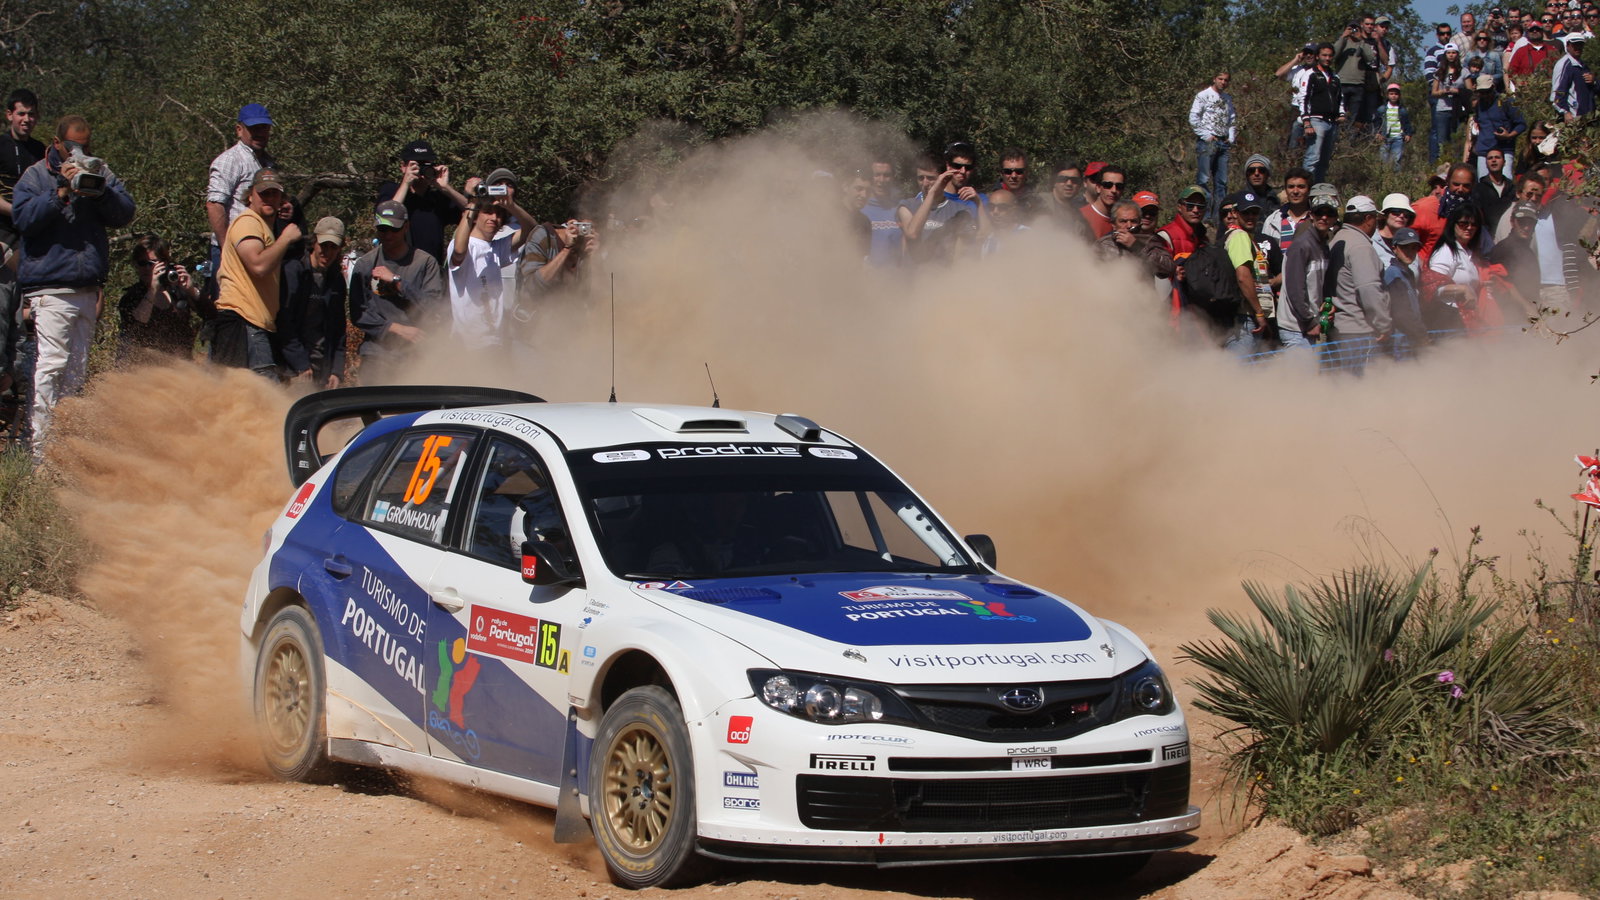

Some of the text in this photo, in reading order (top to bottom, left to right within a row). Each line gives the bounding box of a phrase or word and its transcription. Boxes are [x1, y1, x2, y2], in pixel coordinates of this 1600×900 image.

[440, 411, 541, 440] visitportugal.com
[656, 443, 800, 459] prodrive
[403, 434, 453, 505] 15
[362, 565, 426, 644] TURISMO DE
[841, 602, 914, 612] TURISMO
[845, 608, 969, 622] PORTUGAL
[489, 625, 534, 648] Portugal
[540, 623, 558, 666] 15
[341, 597, 427, 696] PORTUGAL
[558, 651, 569, 674] A
[888, 652, 1097, 669] visitportugal.com
[730, 731, 749, 742] acp
[1007, 746, 1058, 755] prodrive
[810, 753, 876, 771] PIRELLI
[1015, 758, 1048, 768] 1 WRC
[726, 772, 760, 787] ÖHLINS
